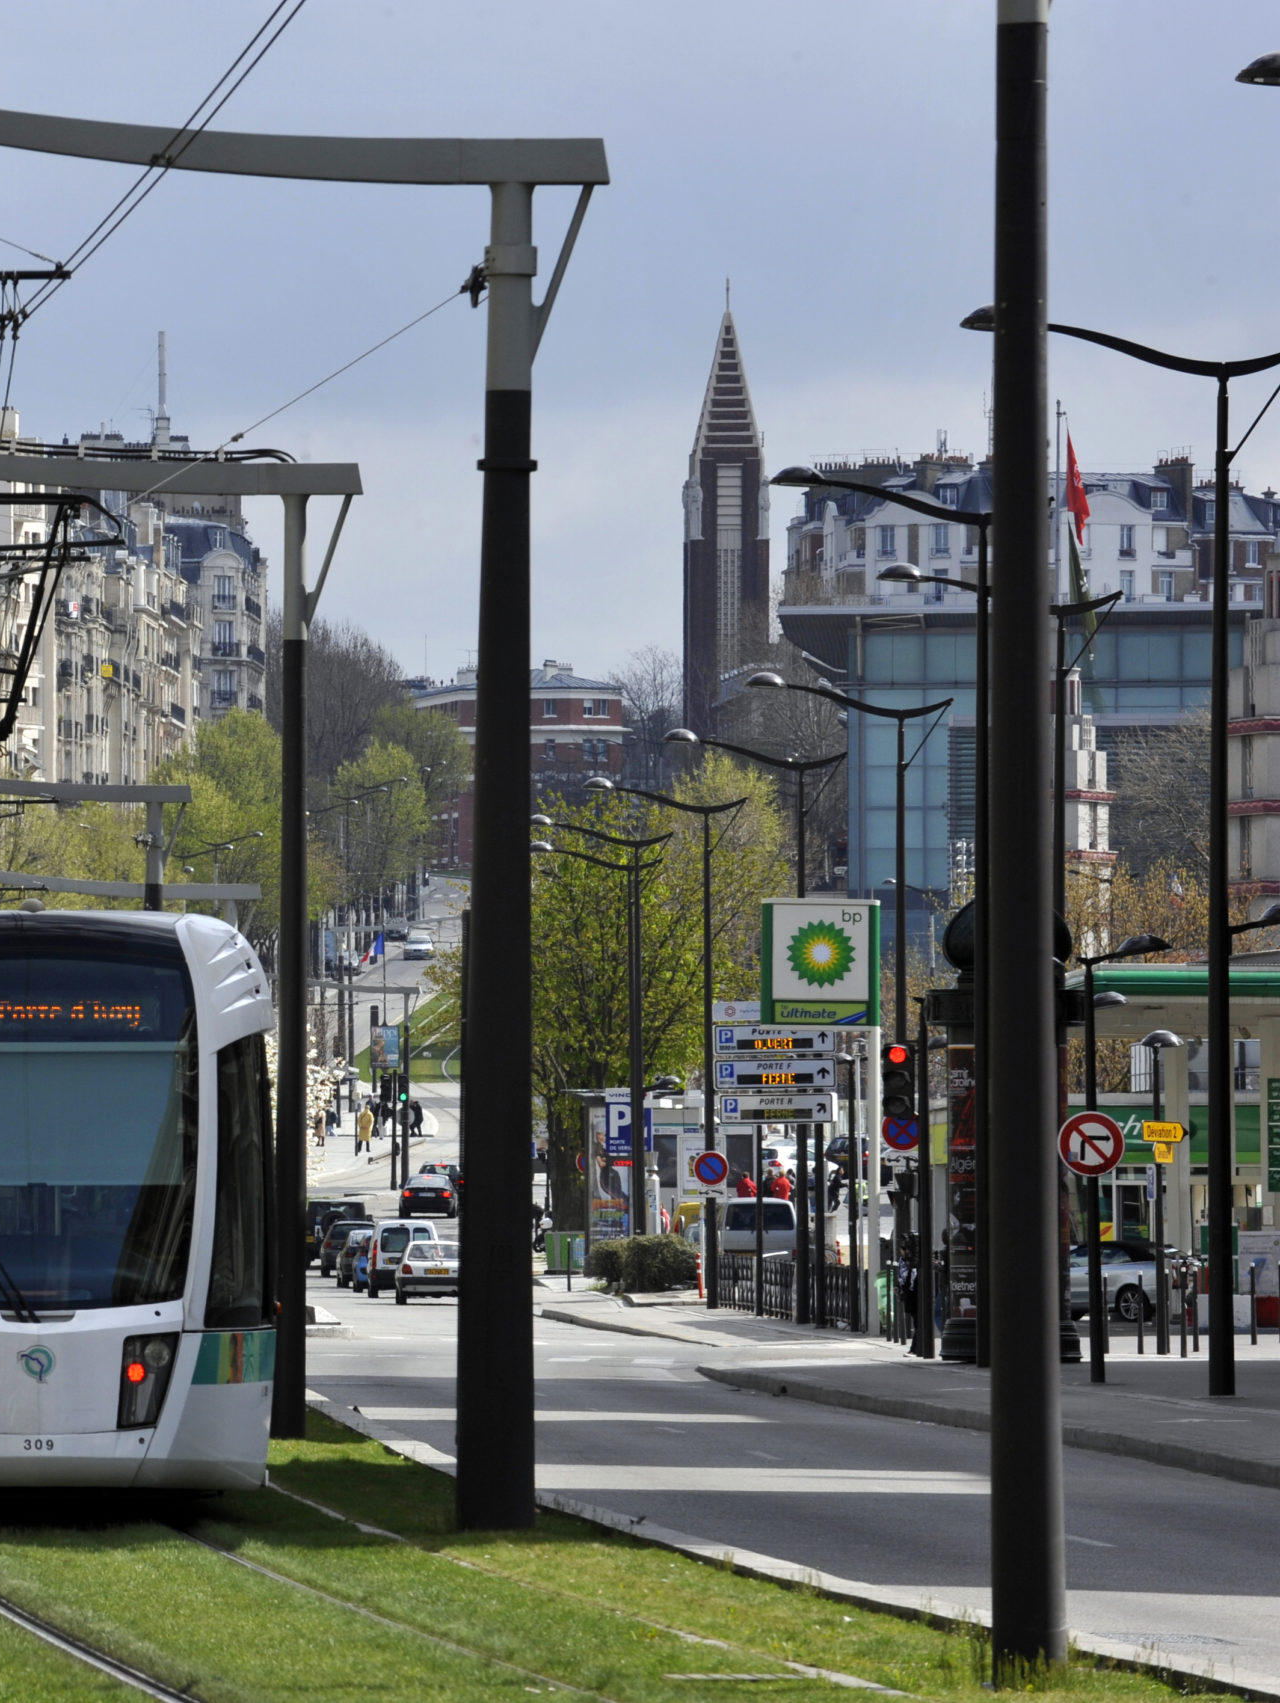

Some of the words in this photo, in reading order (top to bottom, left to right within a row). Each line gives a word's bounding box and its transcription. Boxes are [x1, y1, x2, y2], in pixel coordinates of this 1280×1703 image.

[841, 909, 863, 925] bp
[780, 1008, 838, 1019] ultimate
[756, 1062, 784, 1070] PORTE
[786, 1062, 792, 1070] F
[759, 1098, 784, 1106] PORTE
[609, 1104, 632, 1138] P
[1173, 1126, 1178, 1139] 2
[23, 1439, 55, 1451] 309
